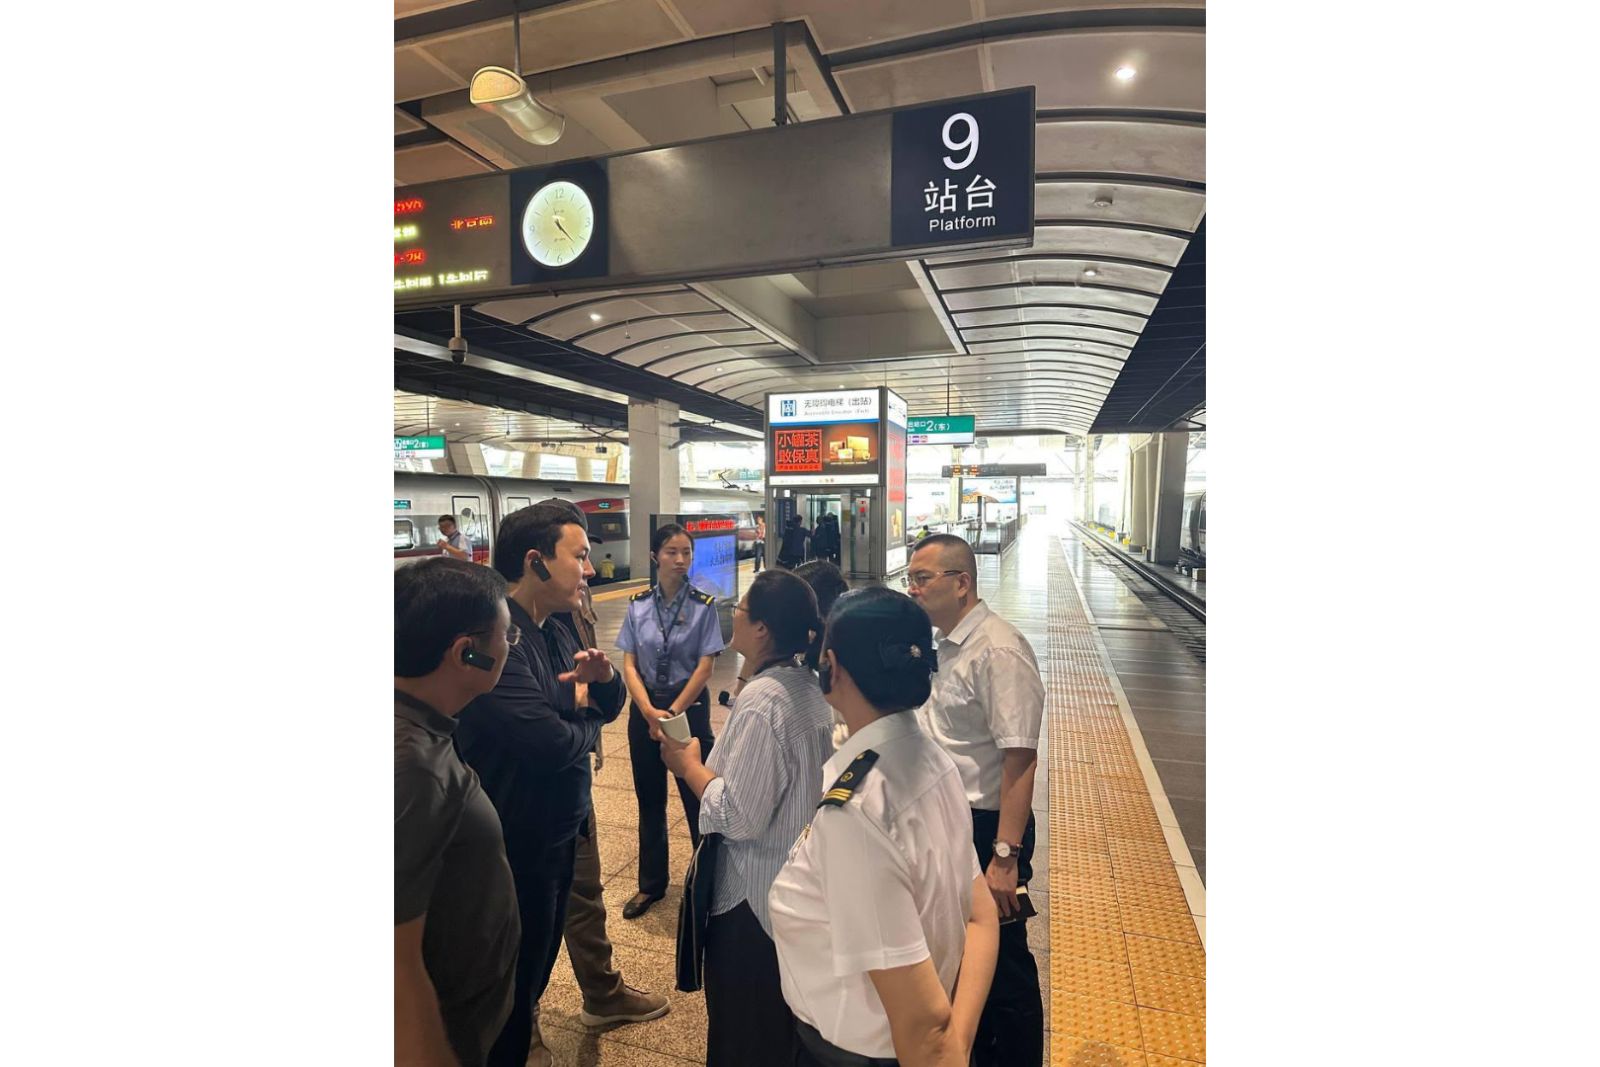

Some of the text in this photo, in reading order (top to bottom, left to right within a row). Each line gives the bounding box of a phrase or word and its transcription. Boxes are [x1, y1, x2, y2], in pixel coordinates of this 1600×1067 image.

[941, 112, 980, 171] 9
[555, 188, 564, 199] 12
[923, 174, 997, 214] 站台
[585, 217, 591, 228] 3
[929, 215, 996, 232] Platform
[529, 225, 536, 233] 9
[556, 254, 563, 264] 6
